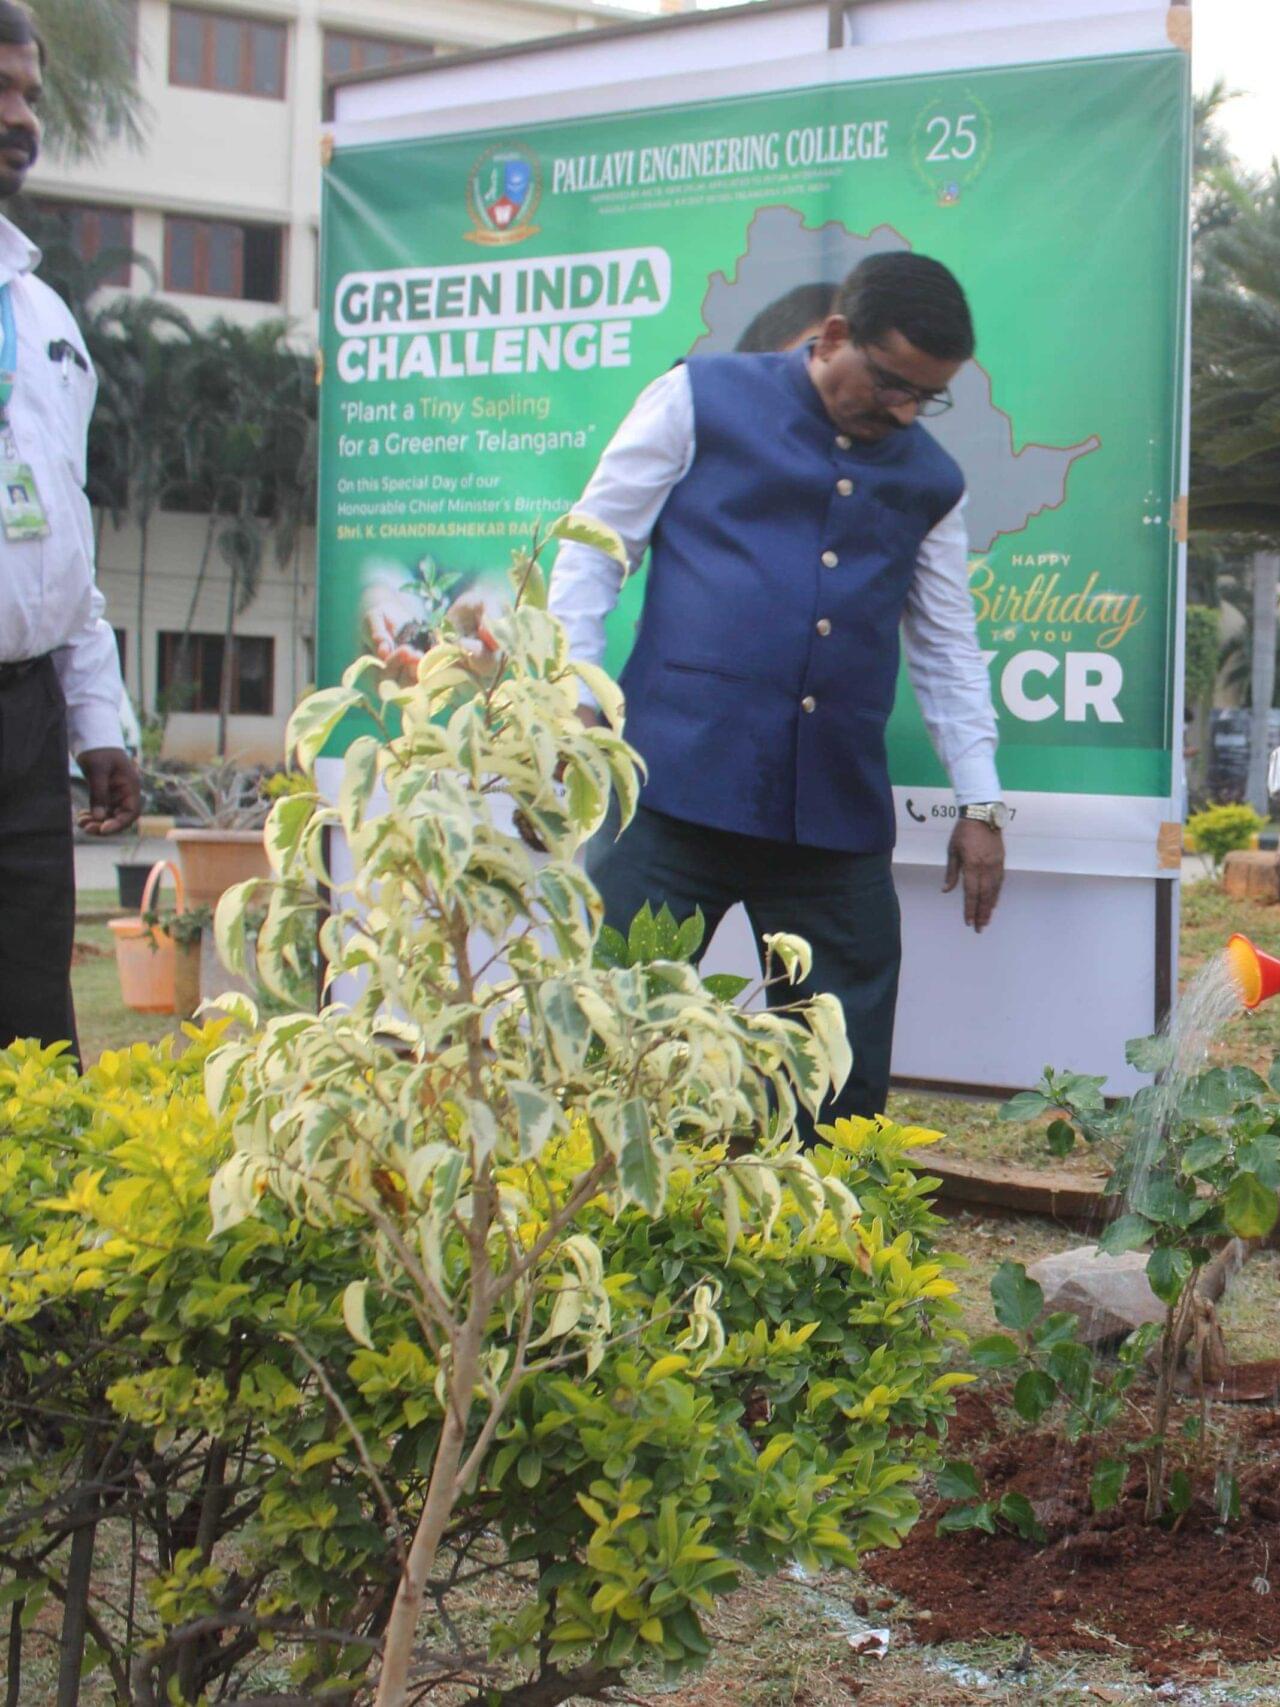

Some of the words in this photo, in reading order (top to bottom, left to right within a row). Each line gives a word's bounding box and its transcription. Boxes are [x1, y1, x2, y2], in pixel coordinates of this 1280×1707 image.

[926, 115, 976, 161] 25
[552, 150, 634, 194] PALLAVI
[639, 133, 780, 185] ENGINEERING
[785, 121, 888, 167] COLLEGE
[341, 273, 500, 326] GREEN
[516, 259, 660, 314] INDIA
[337, 321, 632, 384] CHALLENGE
[403, 405, 415, 420] a
[420, 398, 464, 423] Tiny
[471, 396, 550, 420] Sapling
[338, 436, 364, 457] for
[369, 441, 379, 456] a
[385, 432, 466, 455] Greener
[337, 479, 354, 494] On
[381, 475, 428, 493] Special
[432, 475, 456, 491] Day
[460, 474, 473, 489] of
[476, 477, 501, 489] our
[337, 499, 405, 515] Honourable
[409, 498, 442, 513] Chief
[448, 497, 511, 512] Minister's
[380, 520, 503, 537] CHANDRASHEKAR
[1012, 554, 1071, 567] HAPPY
[967, 556, 1147, 649] Birthday
[991, 630, 1016, 642] TO
[1030, 631, 1073, 643] YOU
[978, 649, 1125, 723] CR
